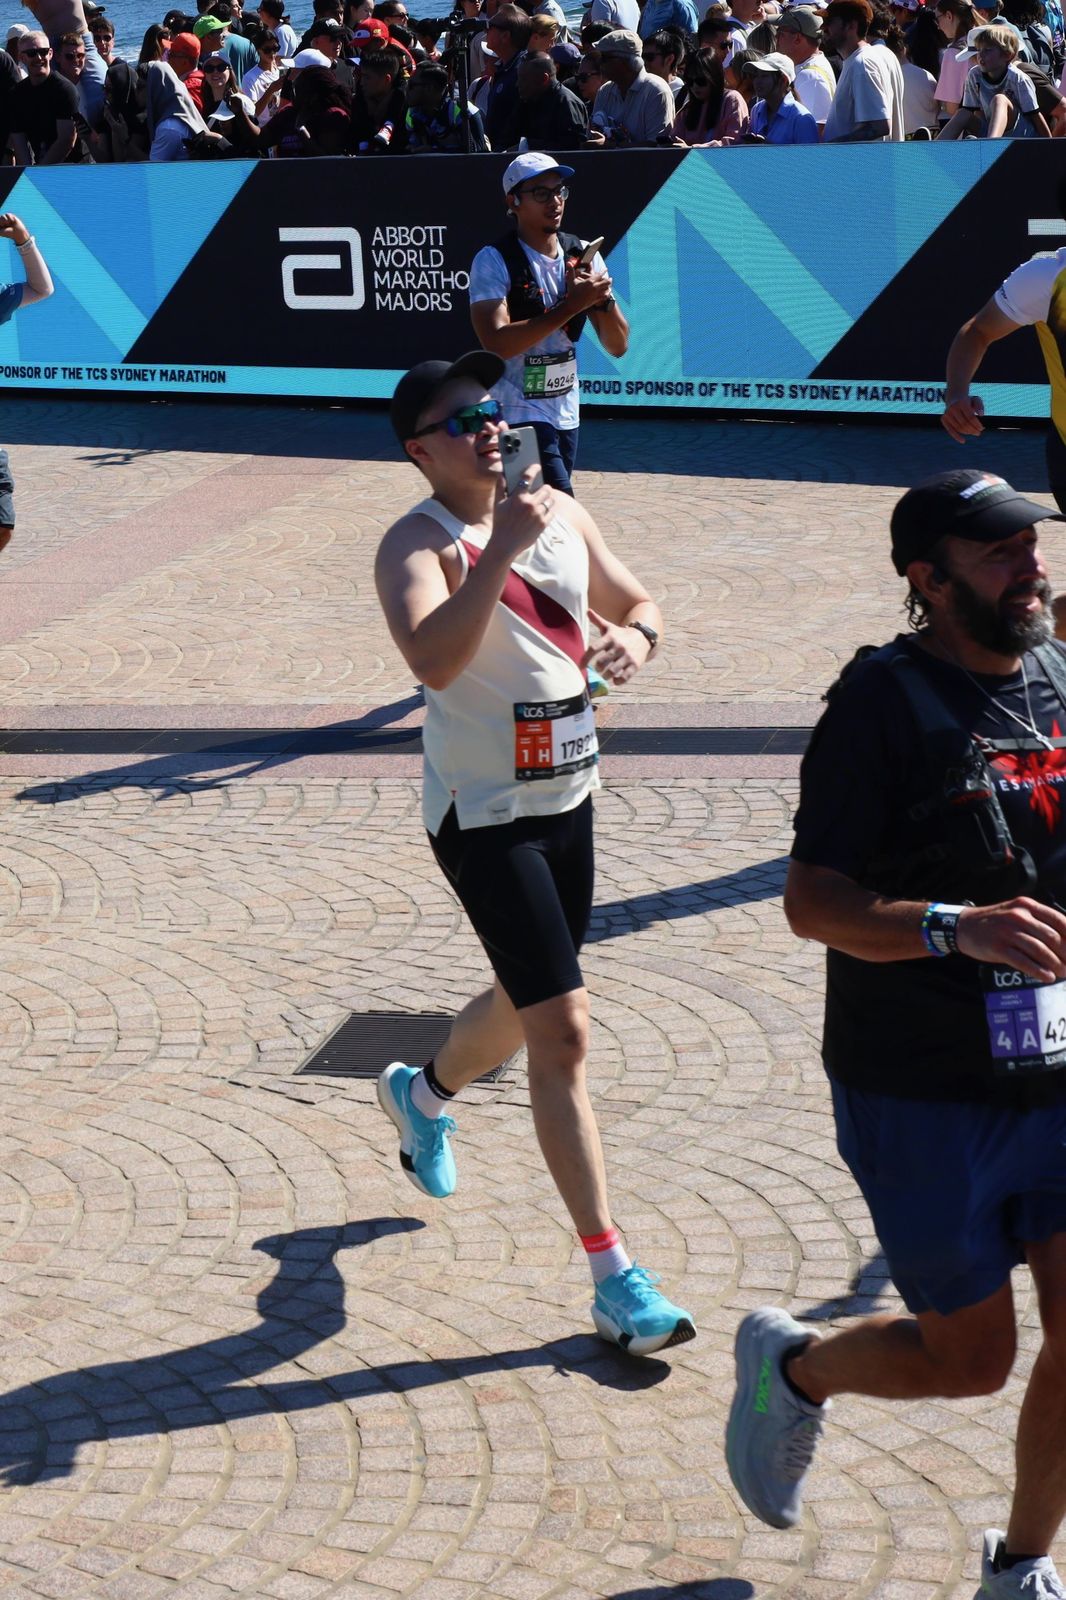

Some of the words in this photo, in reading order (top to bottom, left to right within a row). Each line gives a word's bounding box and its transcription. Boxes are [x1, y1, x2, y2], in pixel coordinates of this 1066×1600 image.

[372, 226, 447, 246] ABBOTT
[372, 249, 444, 268] WORLD
[374, 270, 470, 290] MARATHO
[375, 292, 453, 312] MAJORS
[0, 365, 42, 379] PONSOR
[43, 366, 58, 379] OF
[60, 367, 83, 380] THE
[85, 367, 108, 381] TCS
[110, 368, 157, 382] SYDNEY
[159, 369, 227, 384] MARATHON
[537, 381, 543, 389] E
[625, 381, 695, 396] SPONSOR
[698, 382, 718, 397] OF
[722, 383, 751, 398] THE
[755, 383, 785, 399] TCS
[788, 384, 852, 400] SYDNEY
[856, 386, 947, 403] MARATHON
[523, 706, 544, 718] tcs
[522, 749, 529, 763] 1
[538, 748, 550, 763] H
[561, 733, 594, 759] 1782
[994, 971, 1022, 987] tcs
[998, 1031, 1012, 1050] 4
[1022, 1028, 1038, 1049] A
